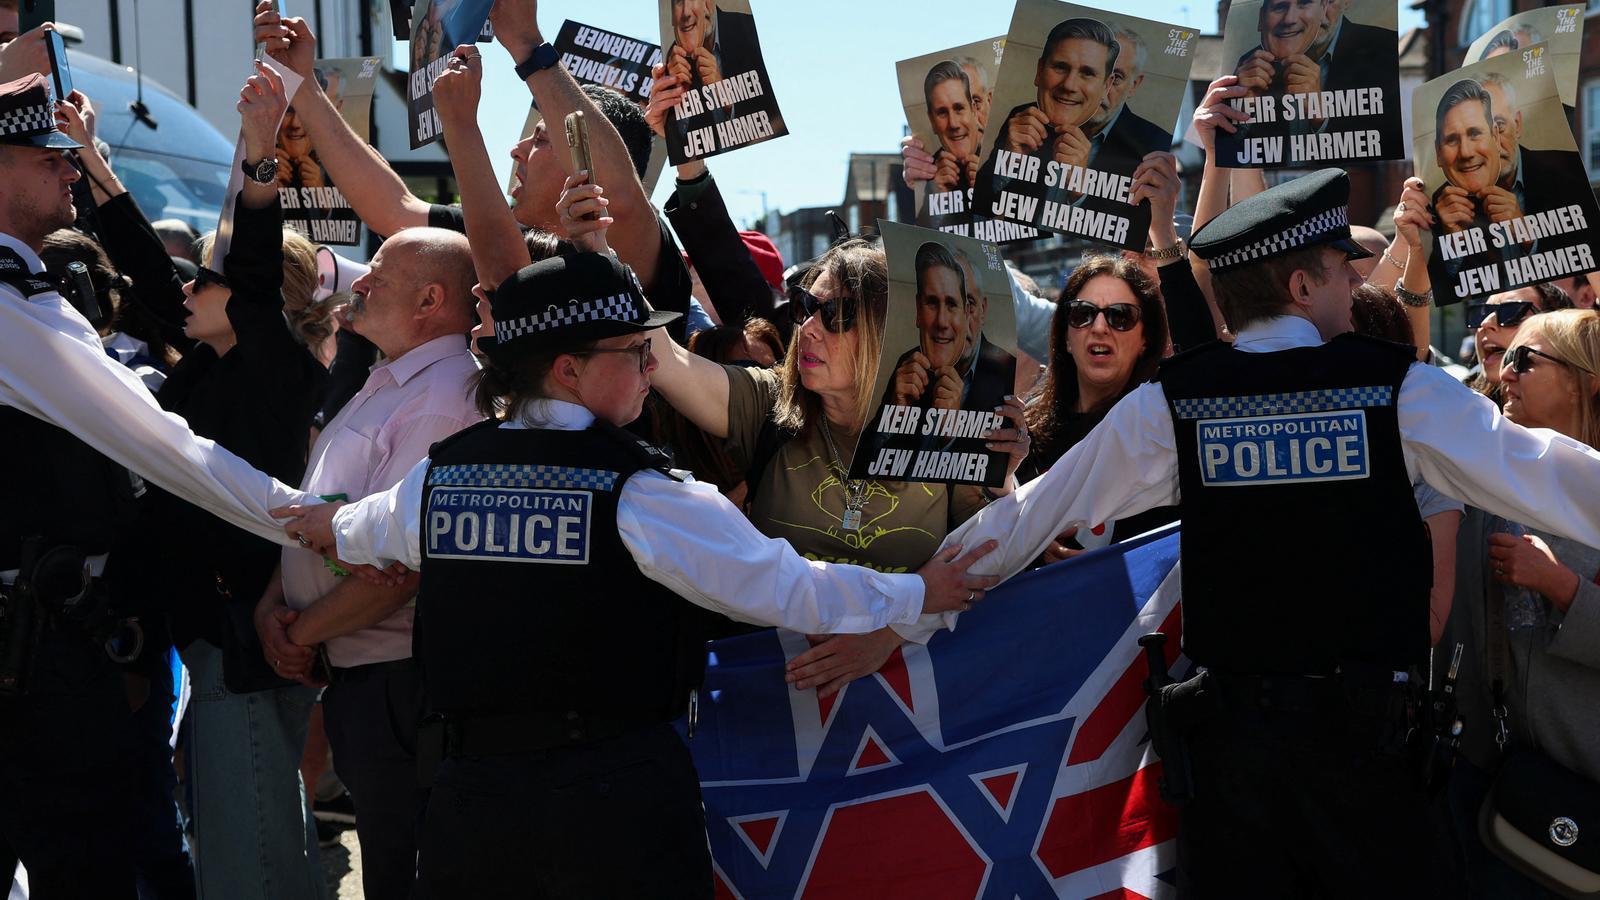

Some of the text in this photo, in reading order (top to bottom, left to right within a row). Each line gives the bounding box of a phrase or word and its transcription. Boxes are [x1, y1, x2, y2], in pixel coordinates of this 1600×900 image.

[1555, 24, 1576, 33] HATE
[1560, 17, 1576, 25] THE
[573, 25, 648, 64] HARMER
[1164, 45, 1188, 57] HATE
[1170, 38, 1188, 48] THE
[1526, 65, 1545, 79] HATE
[1527, 57, 1543, 68] THE
[411, 67, 427, 101] KEIR
[702, 69, 763, 111] STARMER
[1282, 87, 1384, 121] STARMER
[417, 108, 433, 142] JEW
[683, 110, 774, 158] JEW HARMER
[1237, 129, 1382, 164] JEW HARMER
[993, 149, 1041, 183] KEIR
[277, 187, 301, 209] EIR
[929, 189, 964, 216] KEIR
[310, 219, 356, 243] HARMER
[992, 190, 1039, 222] JEW
[1041, 200, 1130, 245] HARMER
[1438, 204, 1588, 261] KEIR STARMER
[1454, 243, 1596, 298] JEW HARMER
[877, 404, 921, 435] KEIR
[1204, 418, 1358, 439] METROPOLITAN
[867, 447, 989, 482] JEW HARMER
[1204, 435, 1361, 479] POLICE
[433, 493, 582, 511] METROPOLITAN
[430, 511, 581, 556] POLICE
